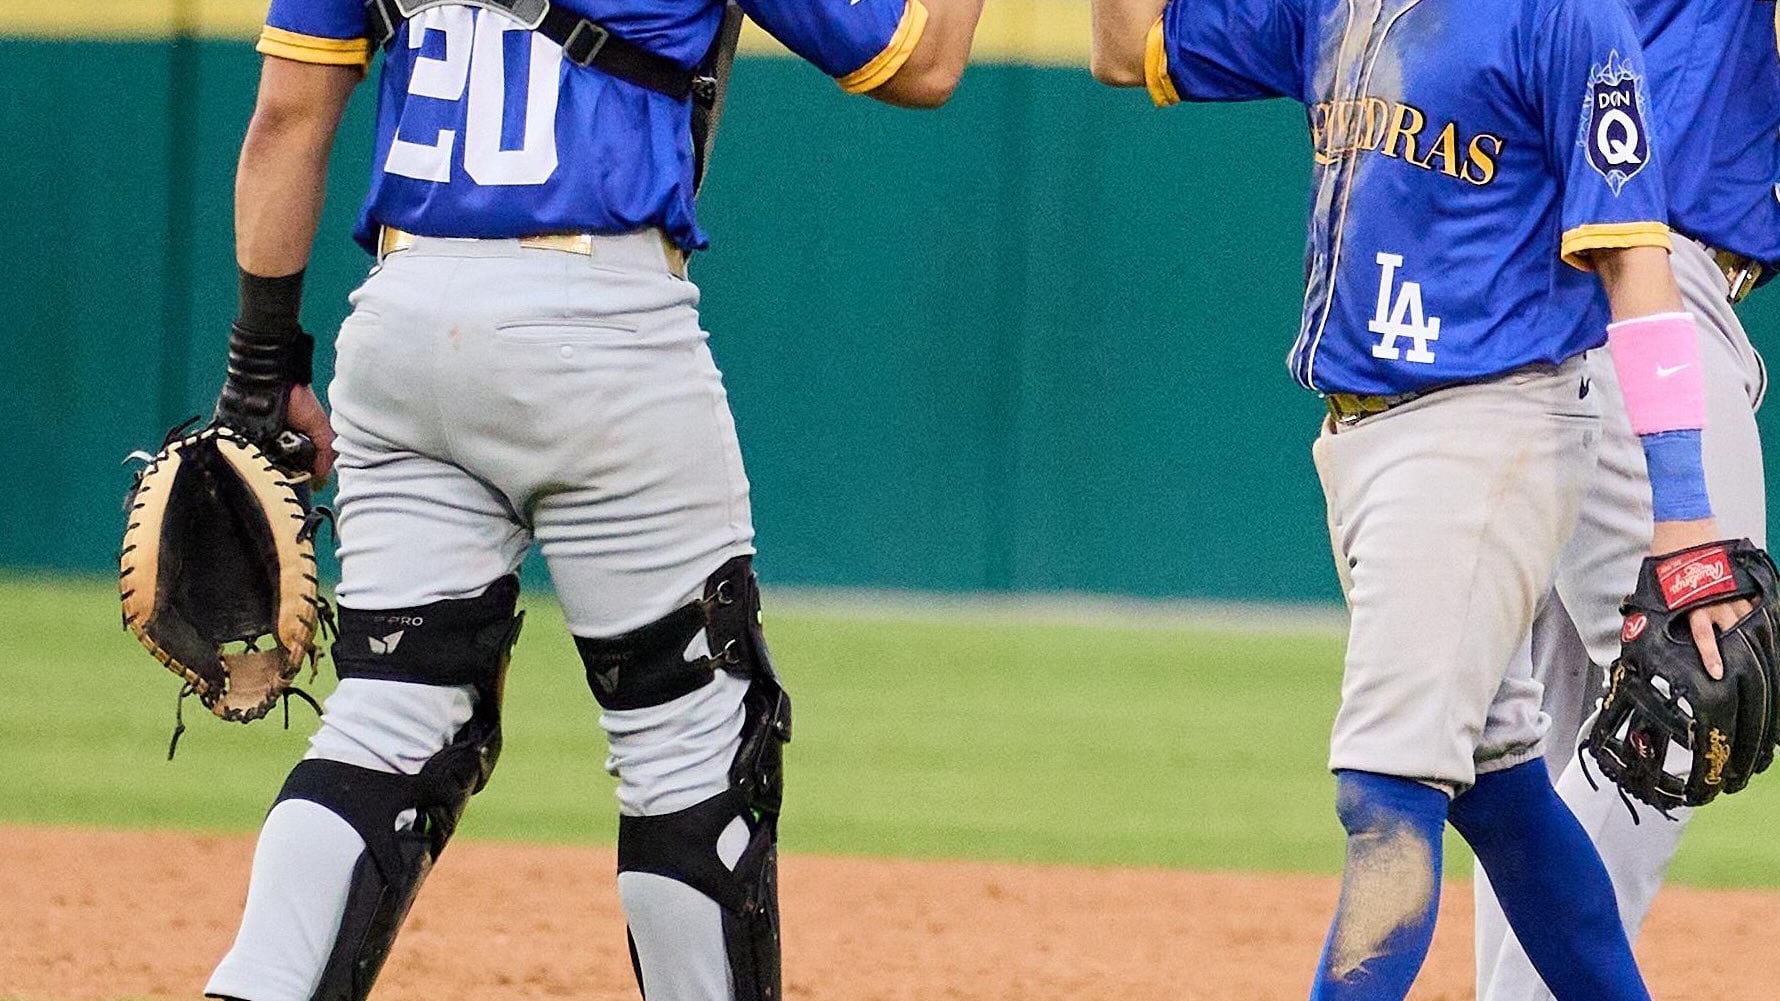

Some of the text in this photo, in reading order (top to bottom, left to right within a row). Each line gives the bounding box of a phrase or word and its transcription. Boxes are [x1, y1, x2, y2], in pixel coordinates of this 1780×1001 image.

[384, 5, 563, 186] 20
[1597, 108, 1642, 165] Q
[1368, 251, 1441, 364] LA
